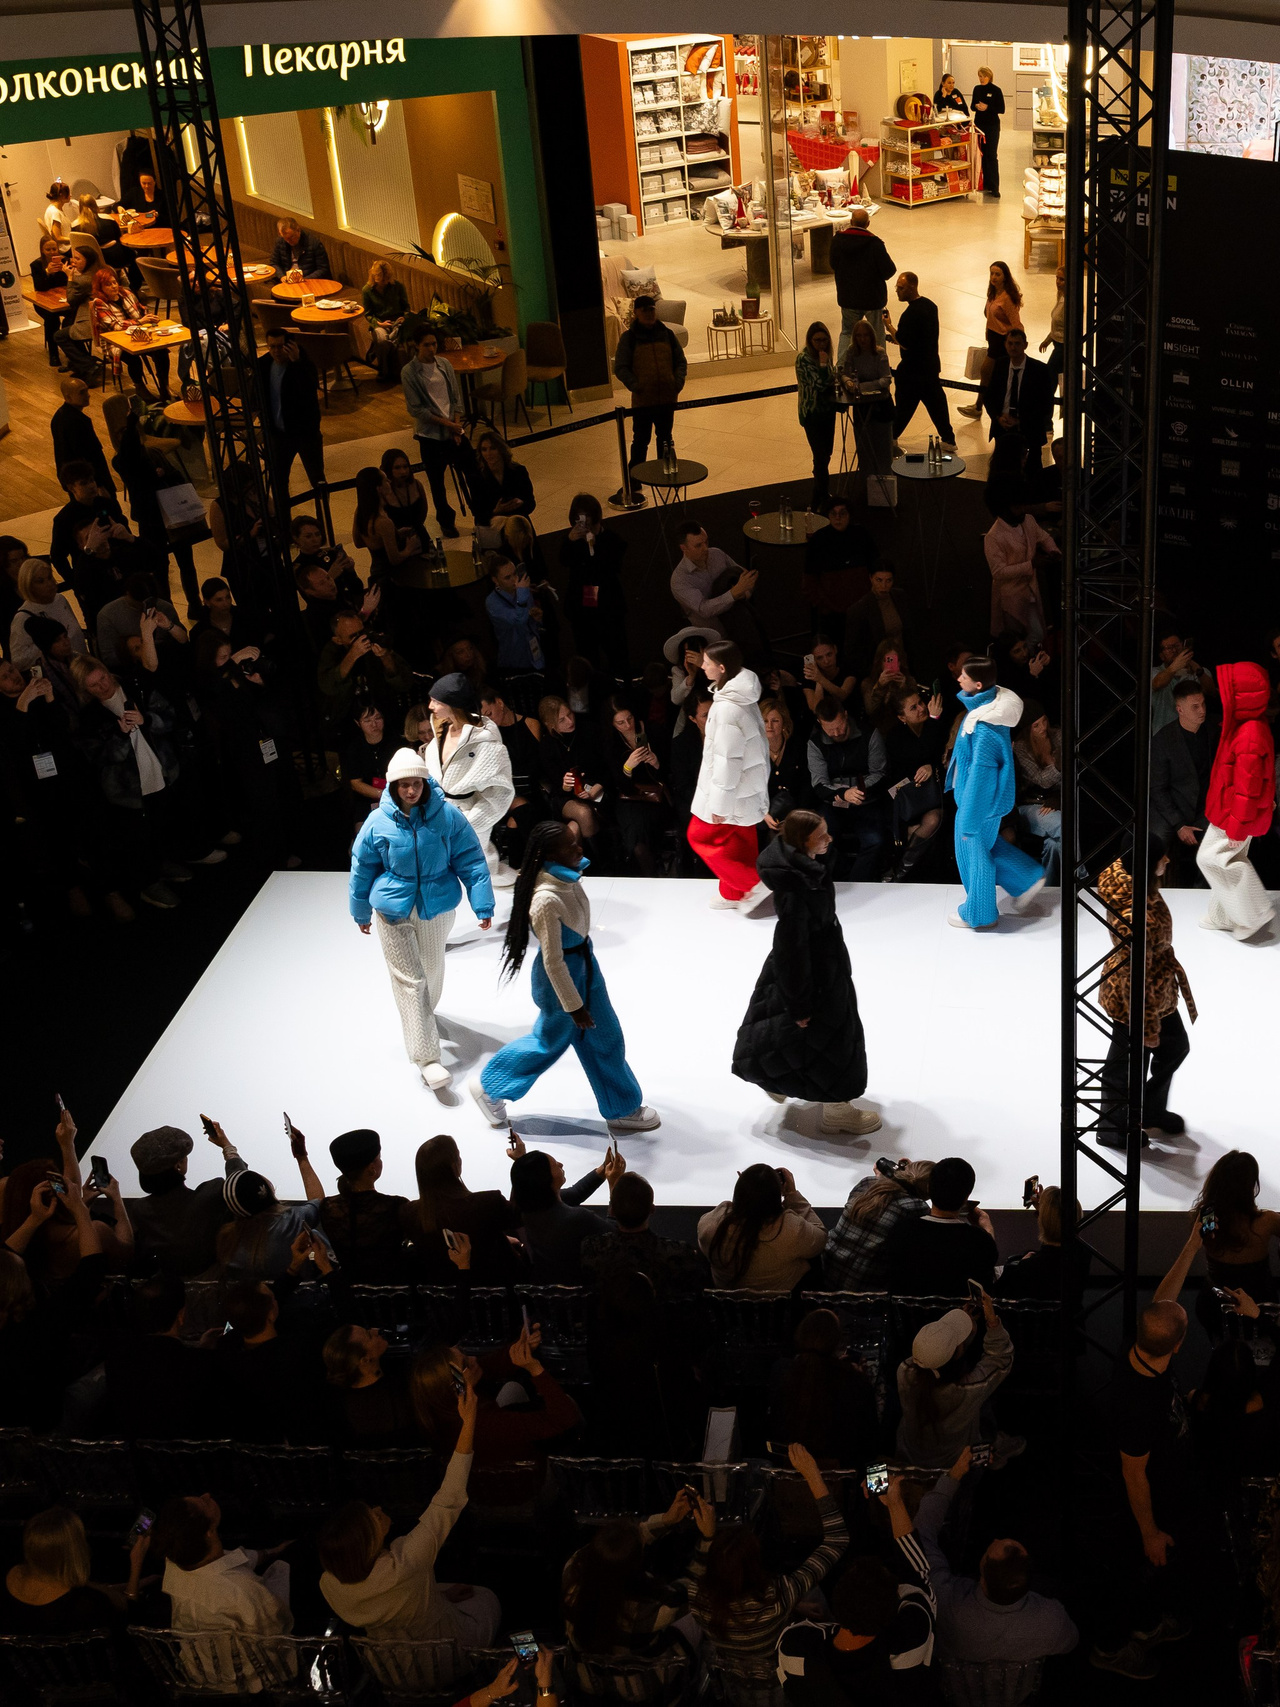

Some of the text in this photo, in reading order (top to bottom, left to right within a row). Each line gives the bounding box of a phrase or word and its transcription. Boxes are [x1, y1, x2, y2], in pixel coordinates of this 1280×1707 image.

[244, 38, 406, 81] Пекарня
[1171, 316, 1196, 326] SOKOL
[1164, 342, 1200, 355] INSIGHT
[1221, 378, 1254, 390] OLLIN
[676, 398, 718, 409] METROPOLIS
[562, 418, 600, 433] METROPOLIS
[1222, 468, 1240, 476] BAR
[1164, 532, 1188, 542] SOKOL
